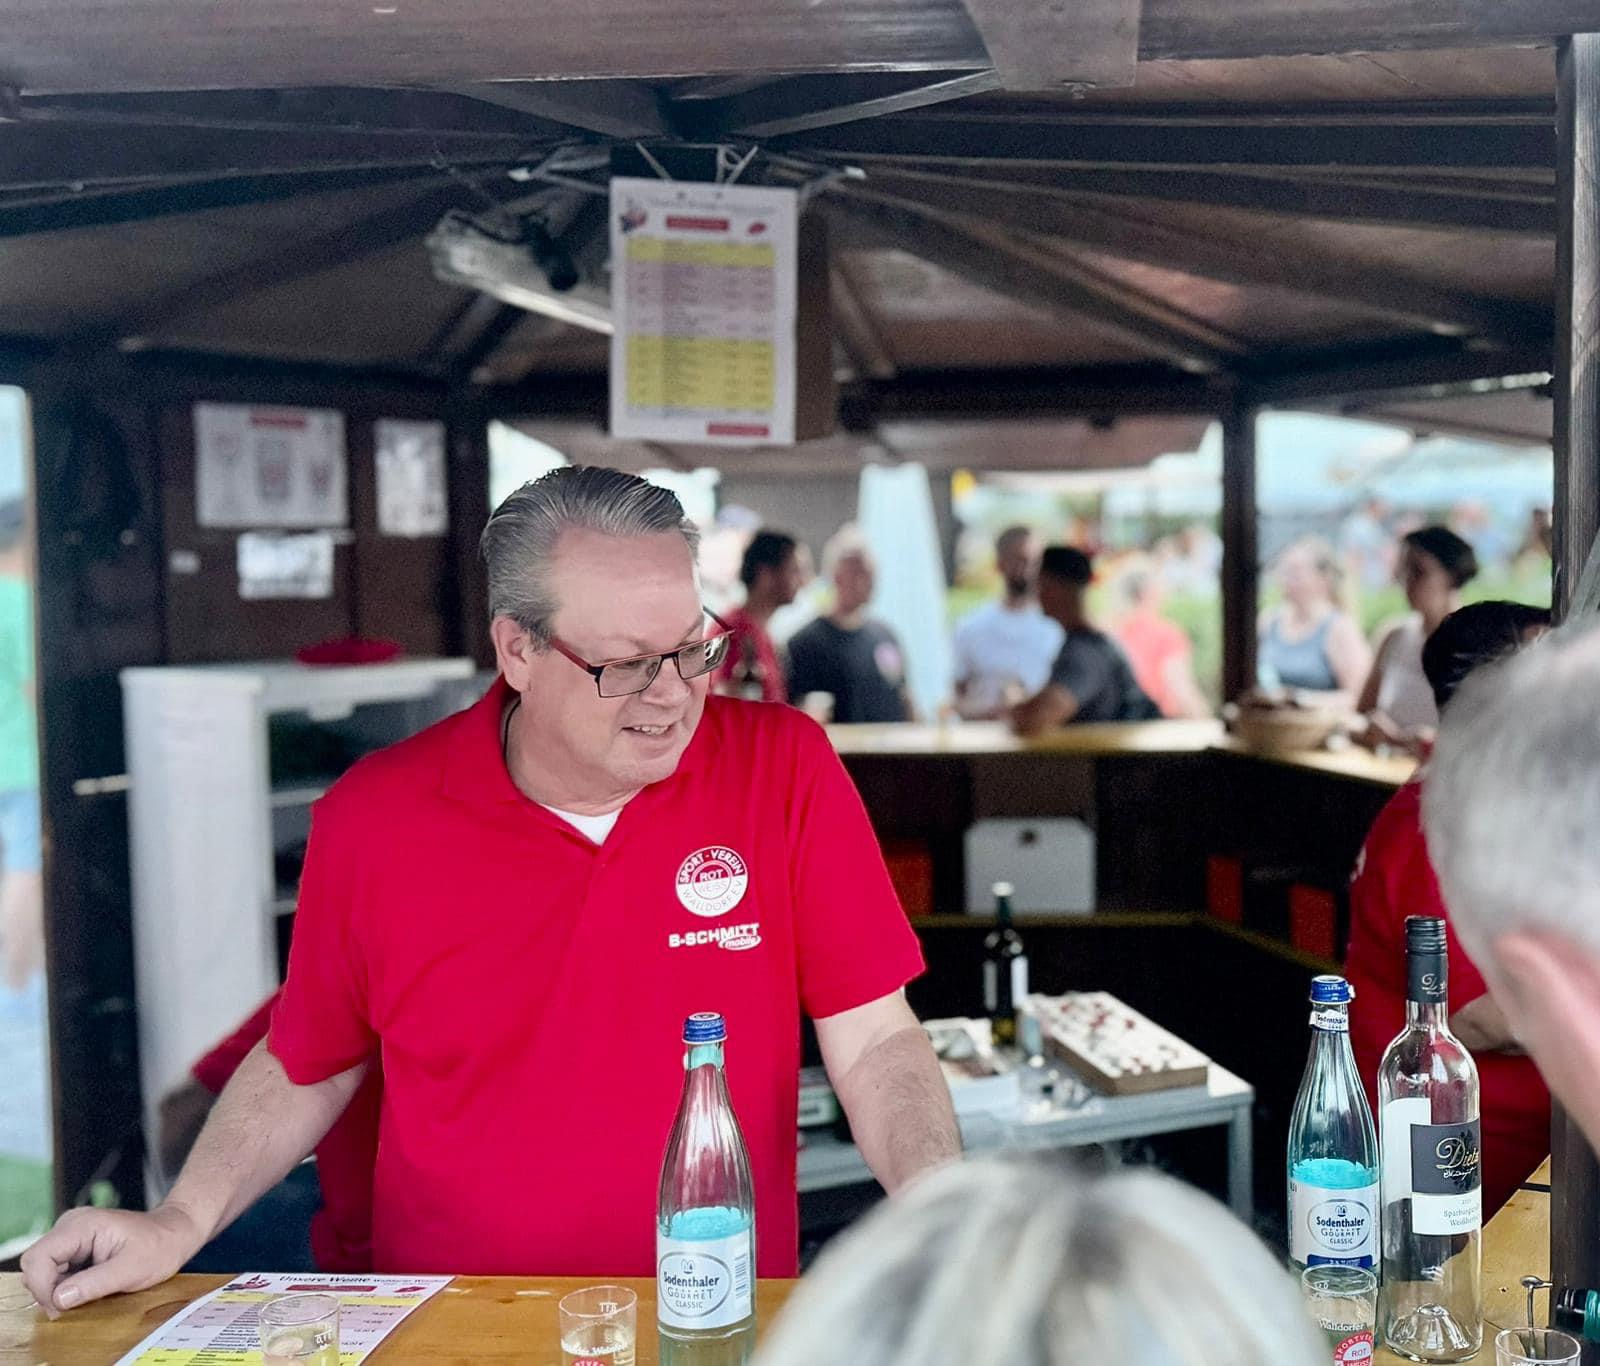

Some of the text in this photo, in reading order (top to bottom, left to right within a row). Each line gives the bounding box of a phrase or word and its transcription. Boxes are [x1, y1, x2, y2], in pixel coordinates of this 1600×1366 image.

[699, 869, 724, 882] ROT
[1316, 1216, 1365, 1228] Sodenthaler
[663, 1271, 720, 1288] Sodenthaler
[675, 1300, 704, 1309] CLASSIC
[1351, 1348, 1367, 1358] ROT
